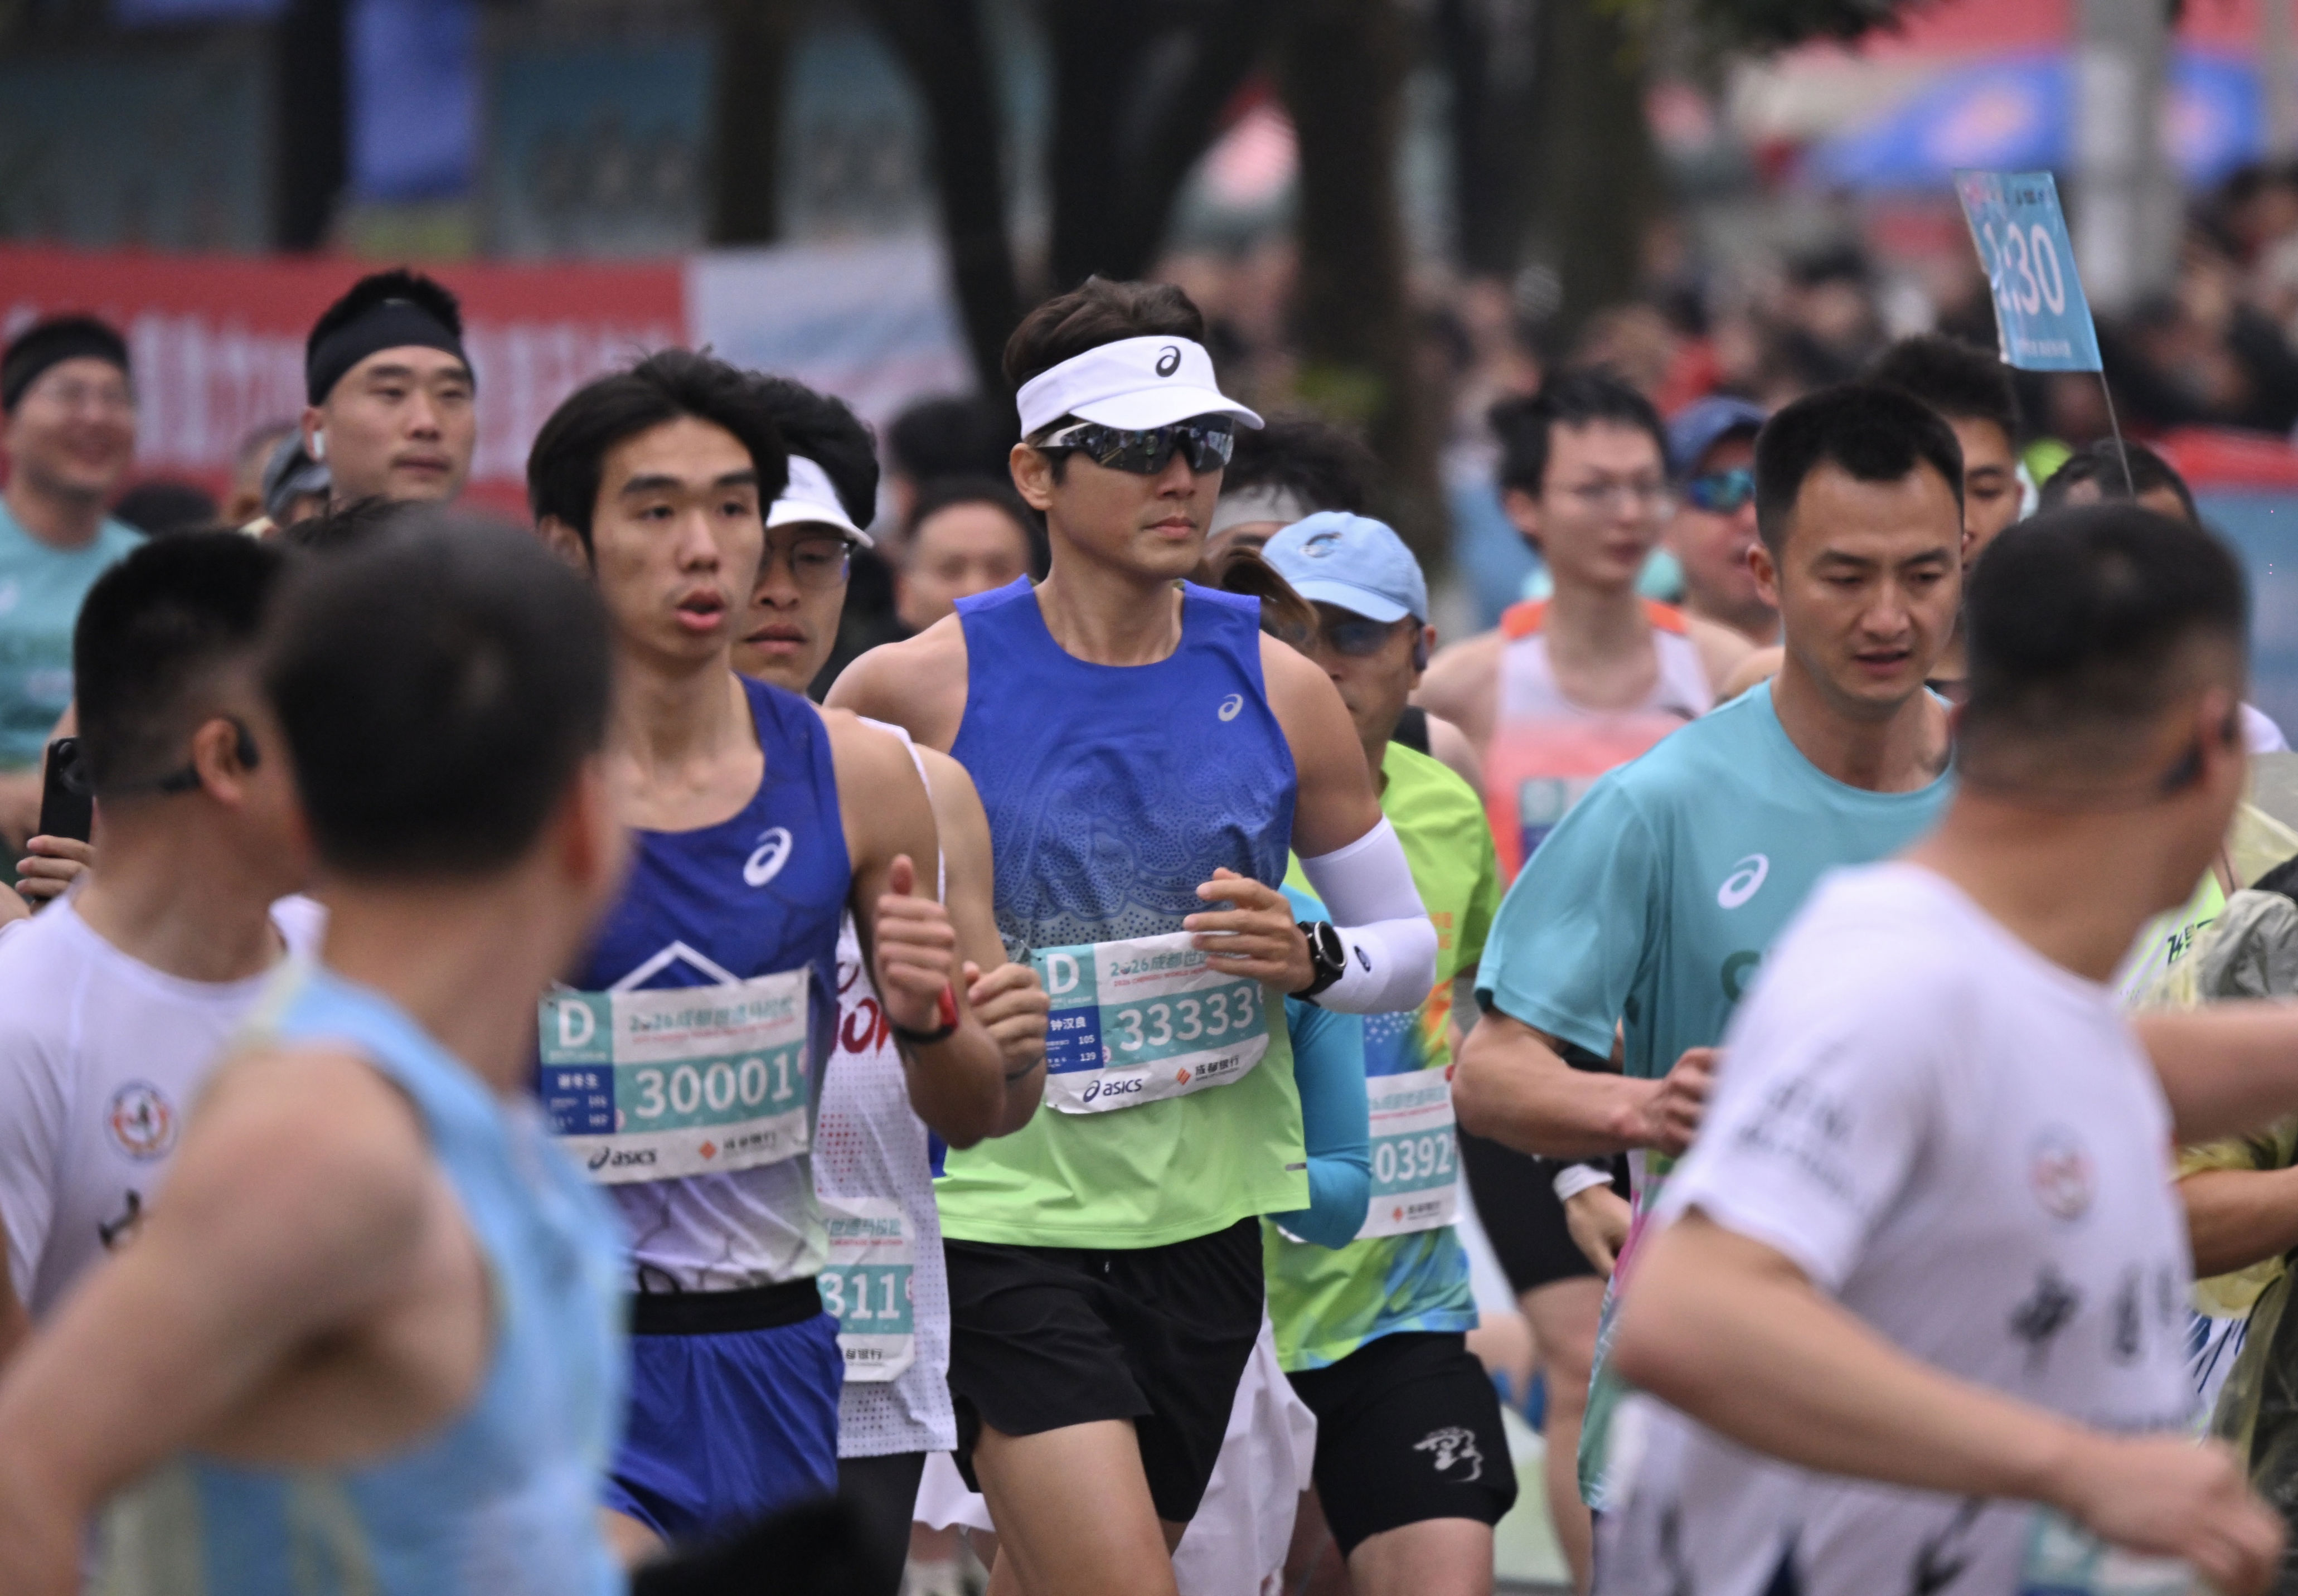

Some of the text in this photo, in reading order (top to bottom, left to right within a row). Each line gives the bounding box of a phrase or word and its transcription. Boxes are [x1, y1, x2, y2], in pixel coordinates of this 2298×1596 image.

[1046, 953, 1080, 995] D
[558, 999, 595, 1048] D
[1117, 987, 1254, 1051] 33333
[634, 1053, 794, 1119] 30001
[1103, 1079, 1142, 1097] asics
[1370, 1133, 1451, 1183] 0392
[818, 1272, 900, 1320] 311
